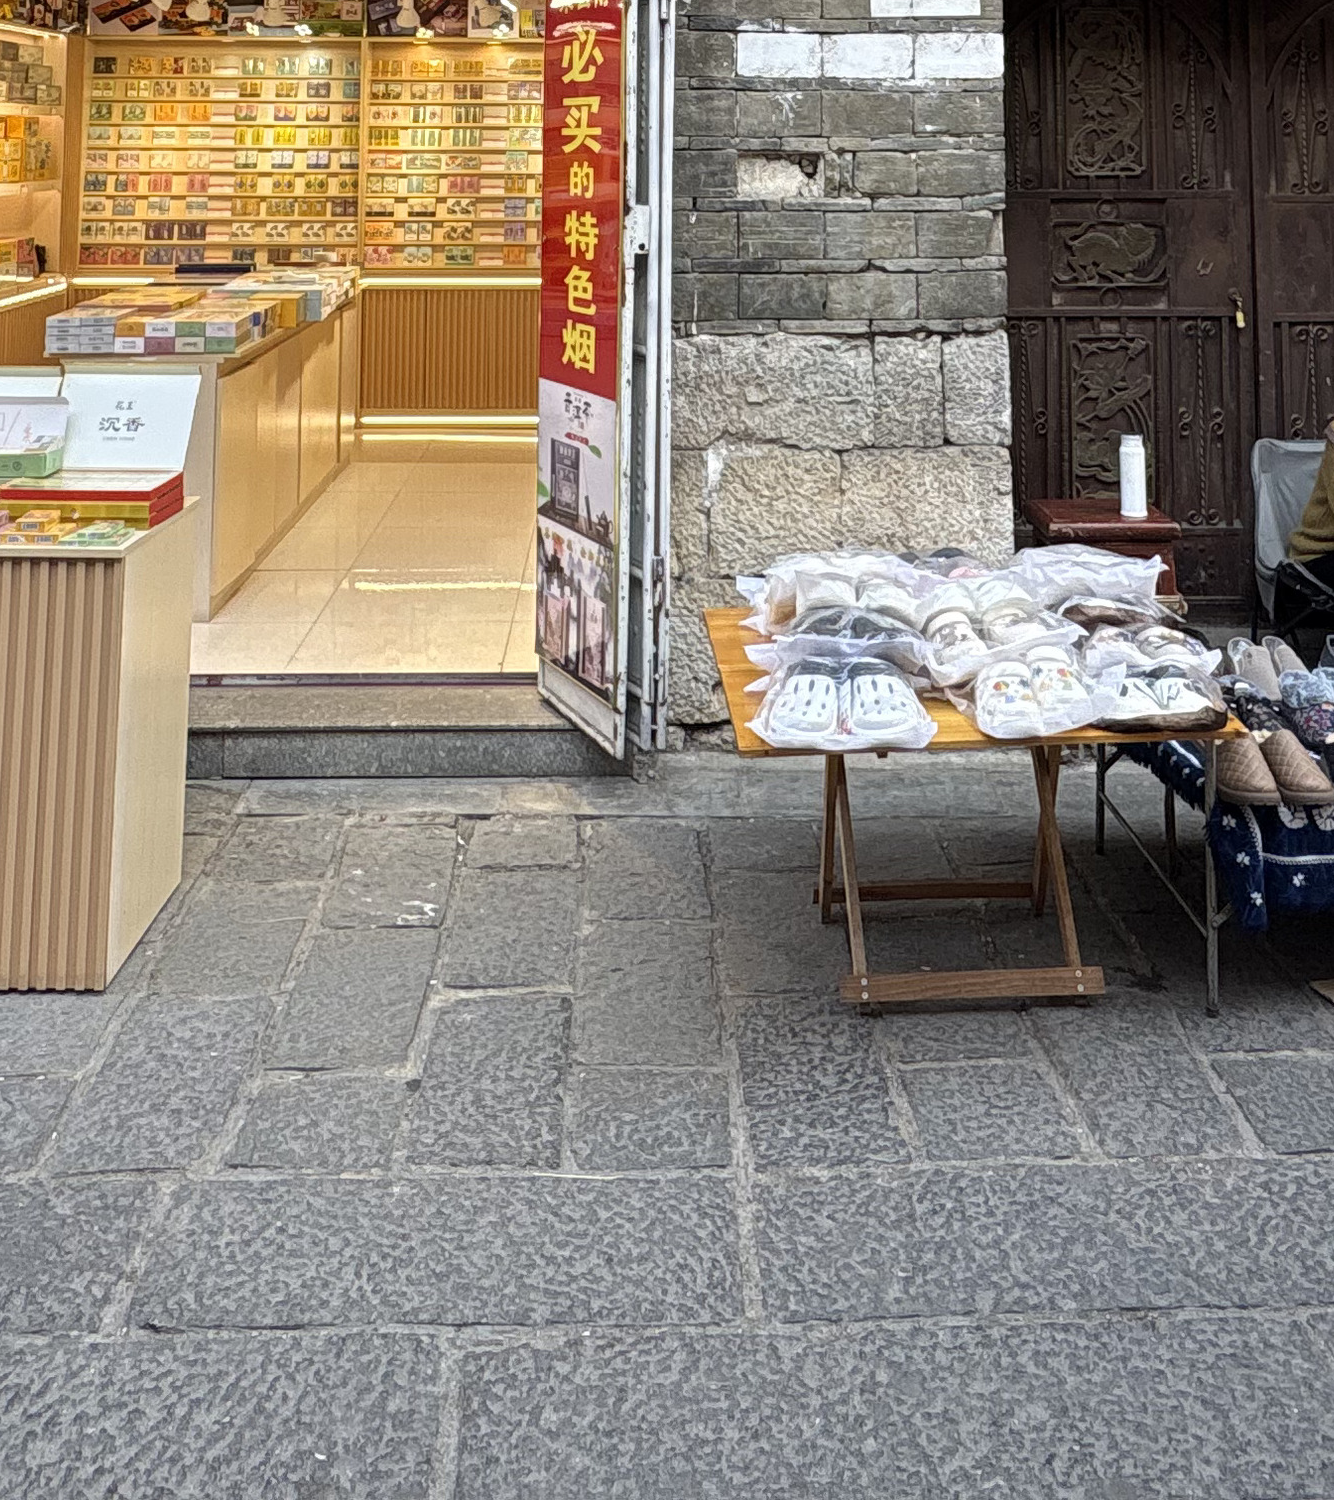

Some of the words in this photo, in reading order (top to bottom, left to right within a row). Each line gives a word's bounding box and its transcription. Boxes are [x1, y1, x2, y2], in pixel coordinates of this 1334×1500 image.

[560, 25, 604, 375] 必买的特色烟
[98, 417, 145, 432] 沉香
